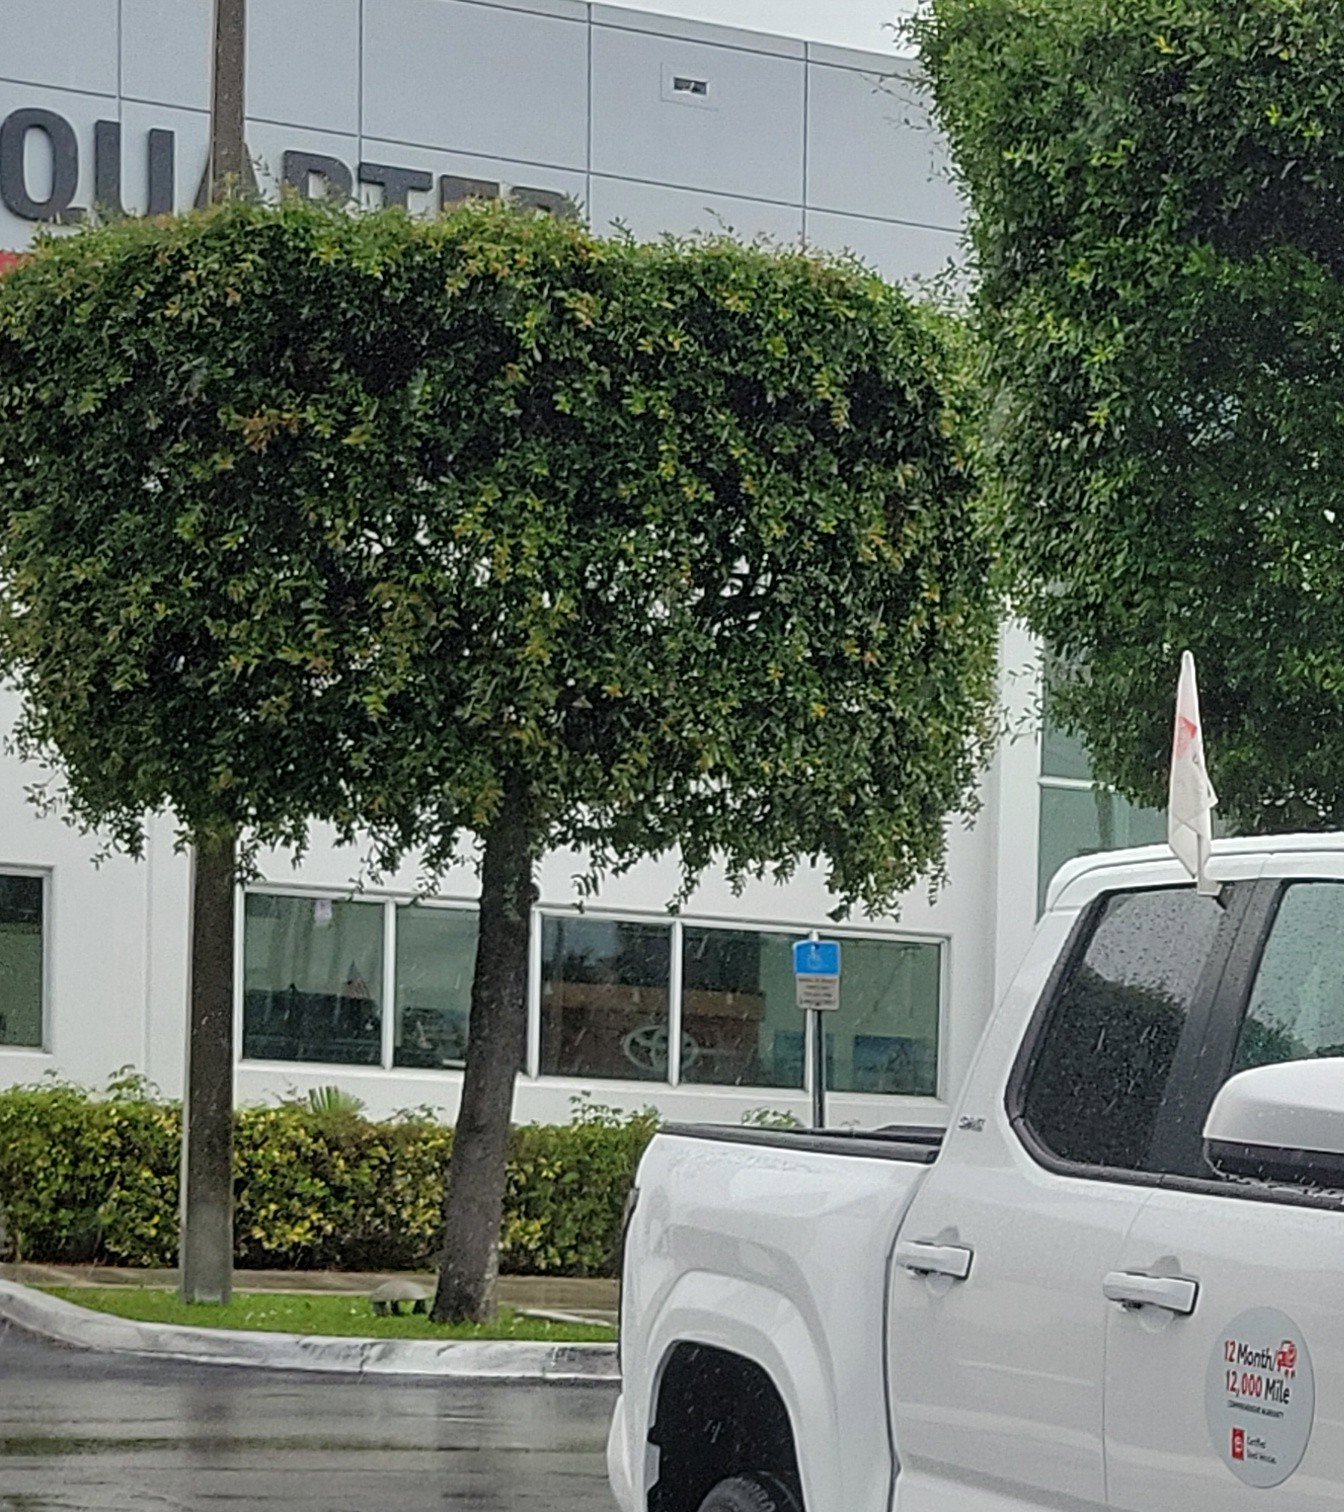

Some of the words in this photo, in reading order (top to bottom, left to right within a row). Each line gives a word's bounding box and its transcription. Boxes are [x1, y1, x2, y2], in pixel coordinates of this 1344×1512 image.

[1224, 1340, 1236, 1363] 12
[1226, 1370, 1263, 1398] 12,000
[1264, 1378, 1290, 1405] Mile
